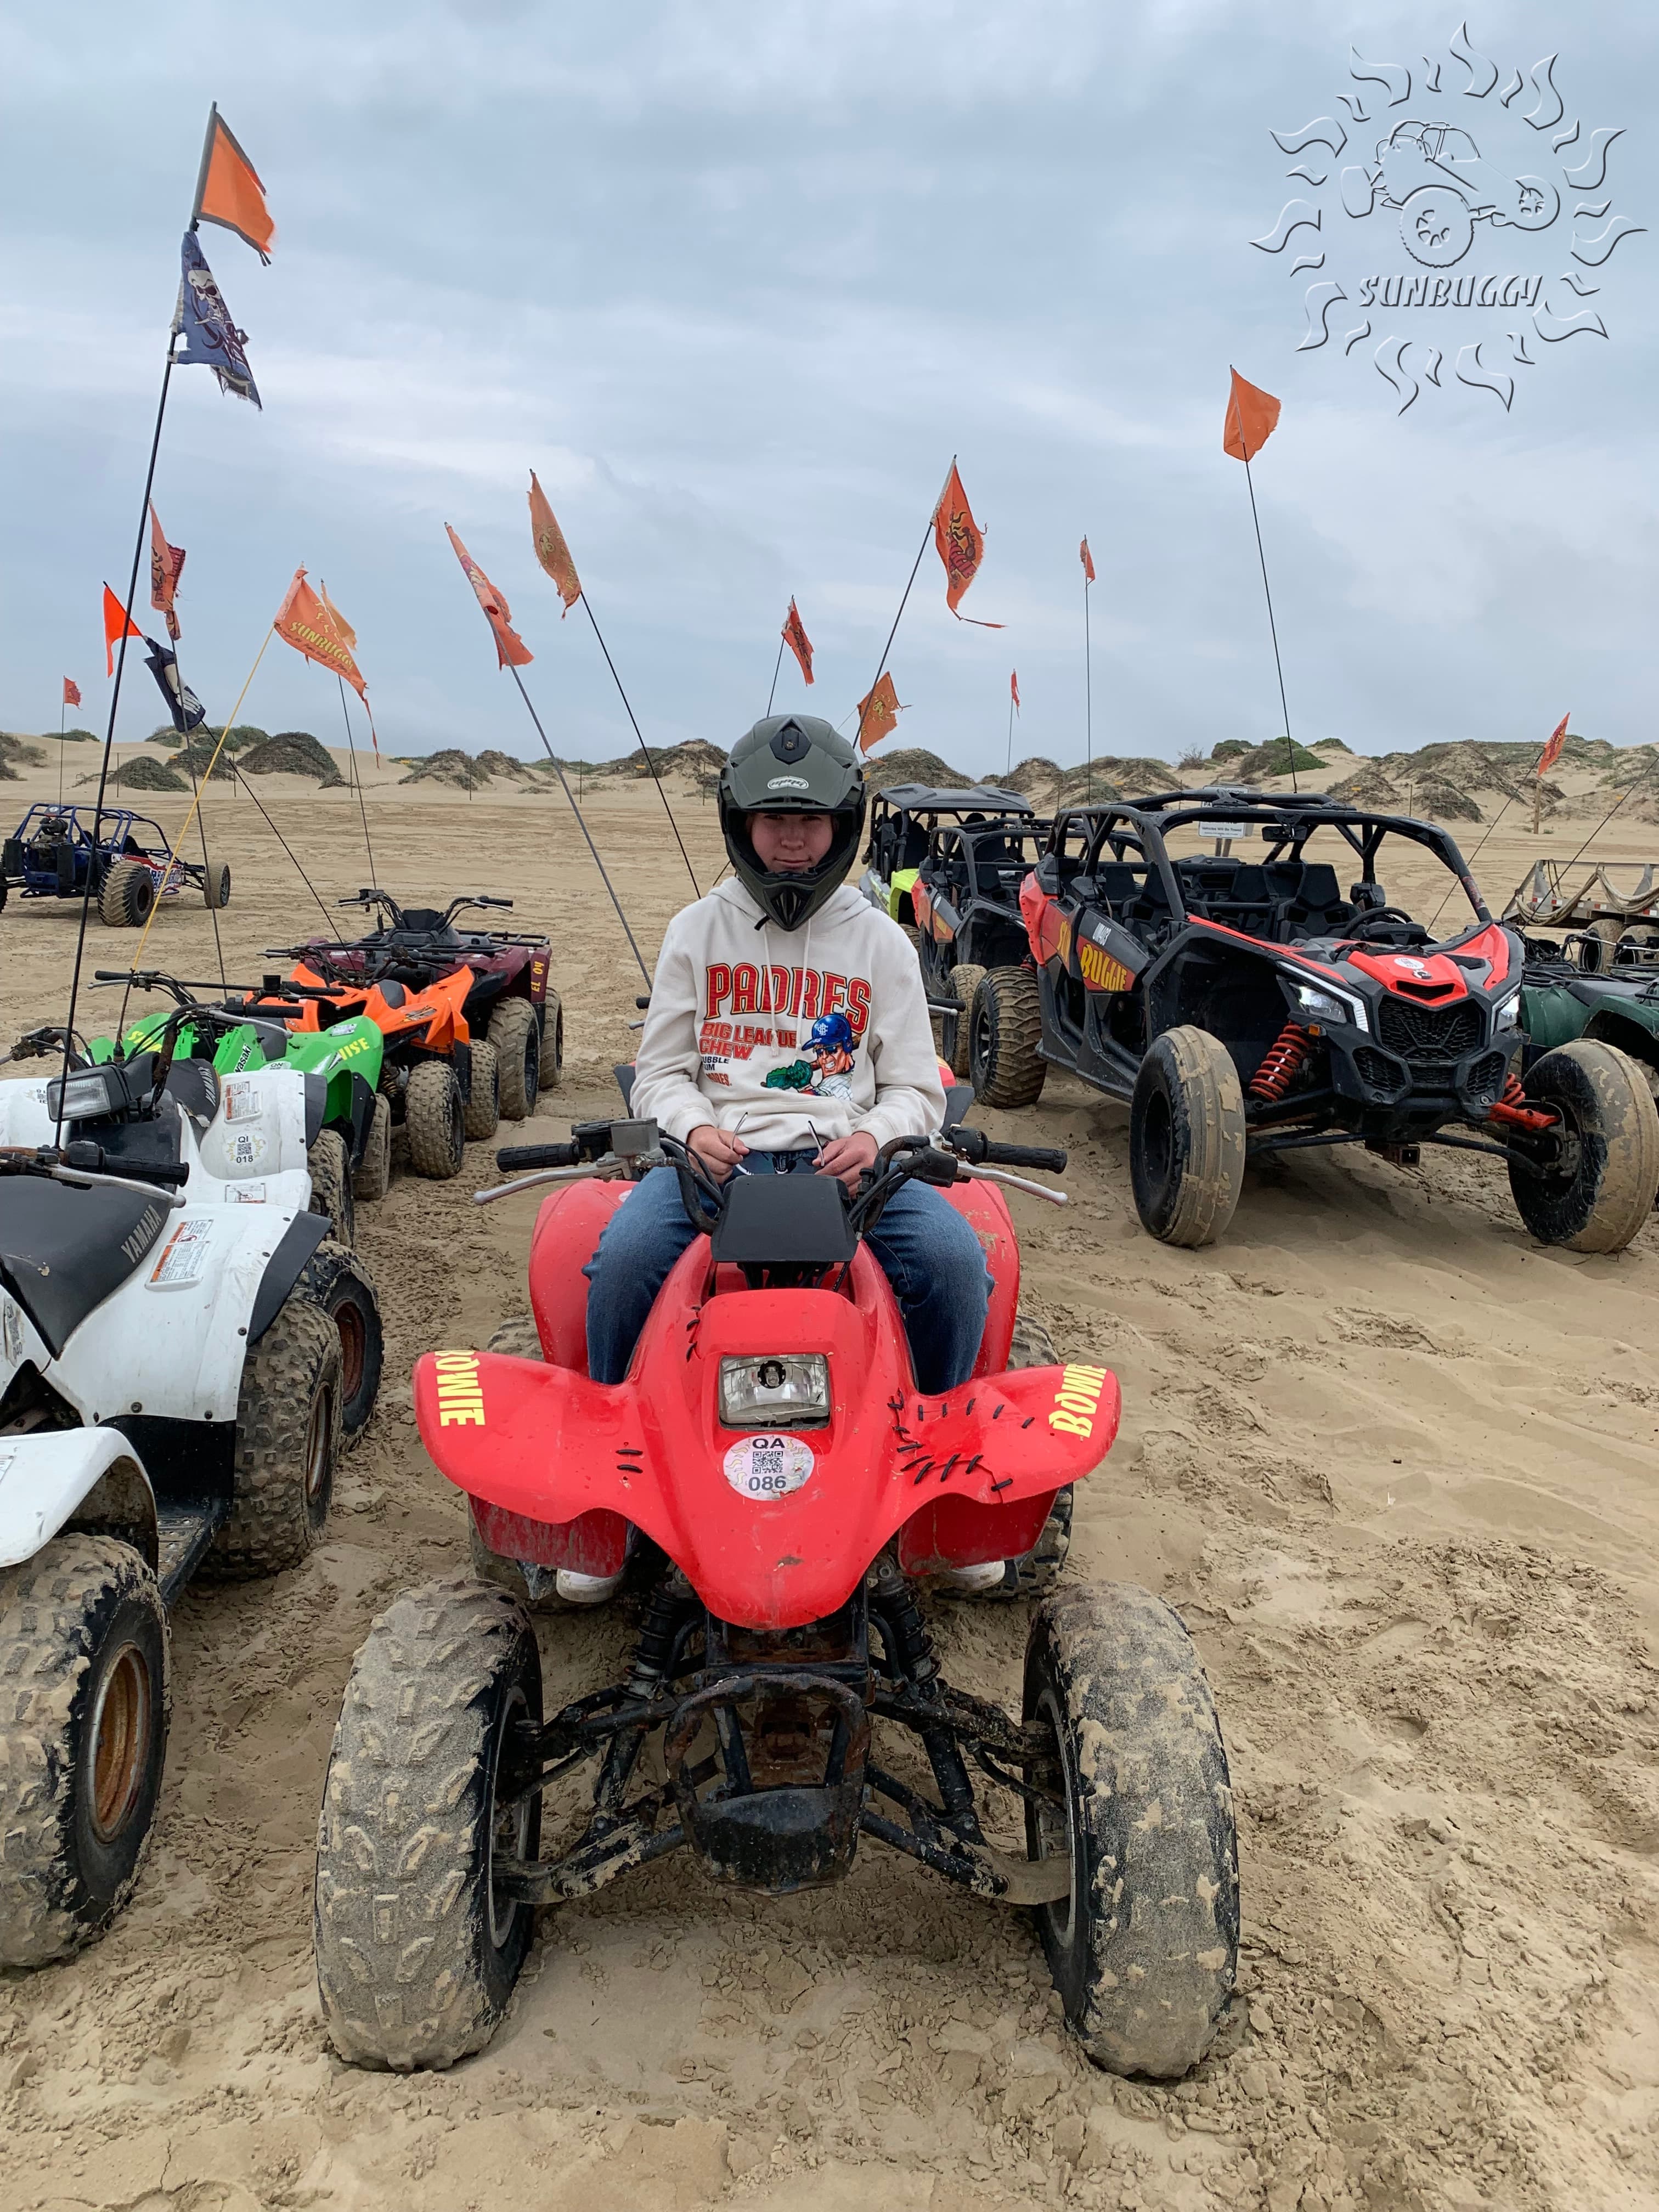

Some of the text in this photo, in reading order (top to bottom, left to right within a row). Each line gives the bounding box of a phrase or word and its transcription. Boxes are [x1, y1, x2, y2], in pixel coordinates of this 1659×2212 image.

[703, 962, 872, 1035] PADRES
[700, 1022, 732, 1040] BIG
[235, 1043, 252, 1073] wasaki
[699, 1037, 754, 1060] CHEW
[198, 1066, 216, 1107] YAMAHA
[236, 1155, 253, 1164] 018
[120, 1204, 162, 1264] YAMAHA
[752, 1438, 786, 1449] QA
[748, 1475, 787, 1491] 086
